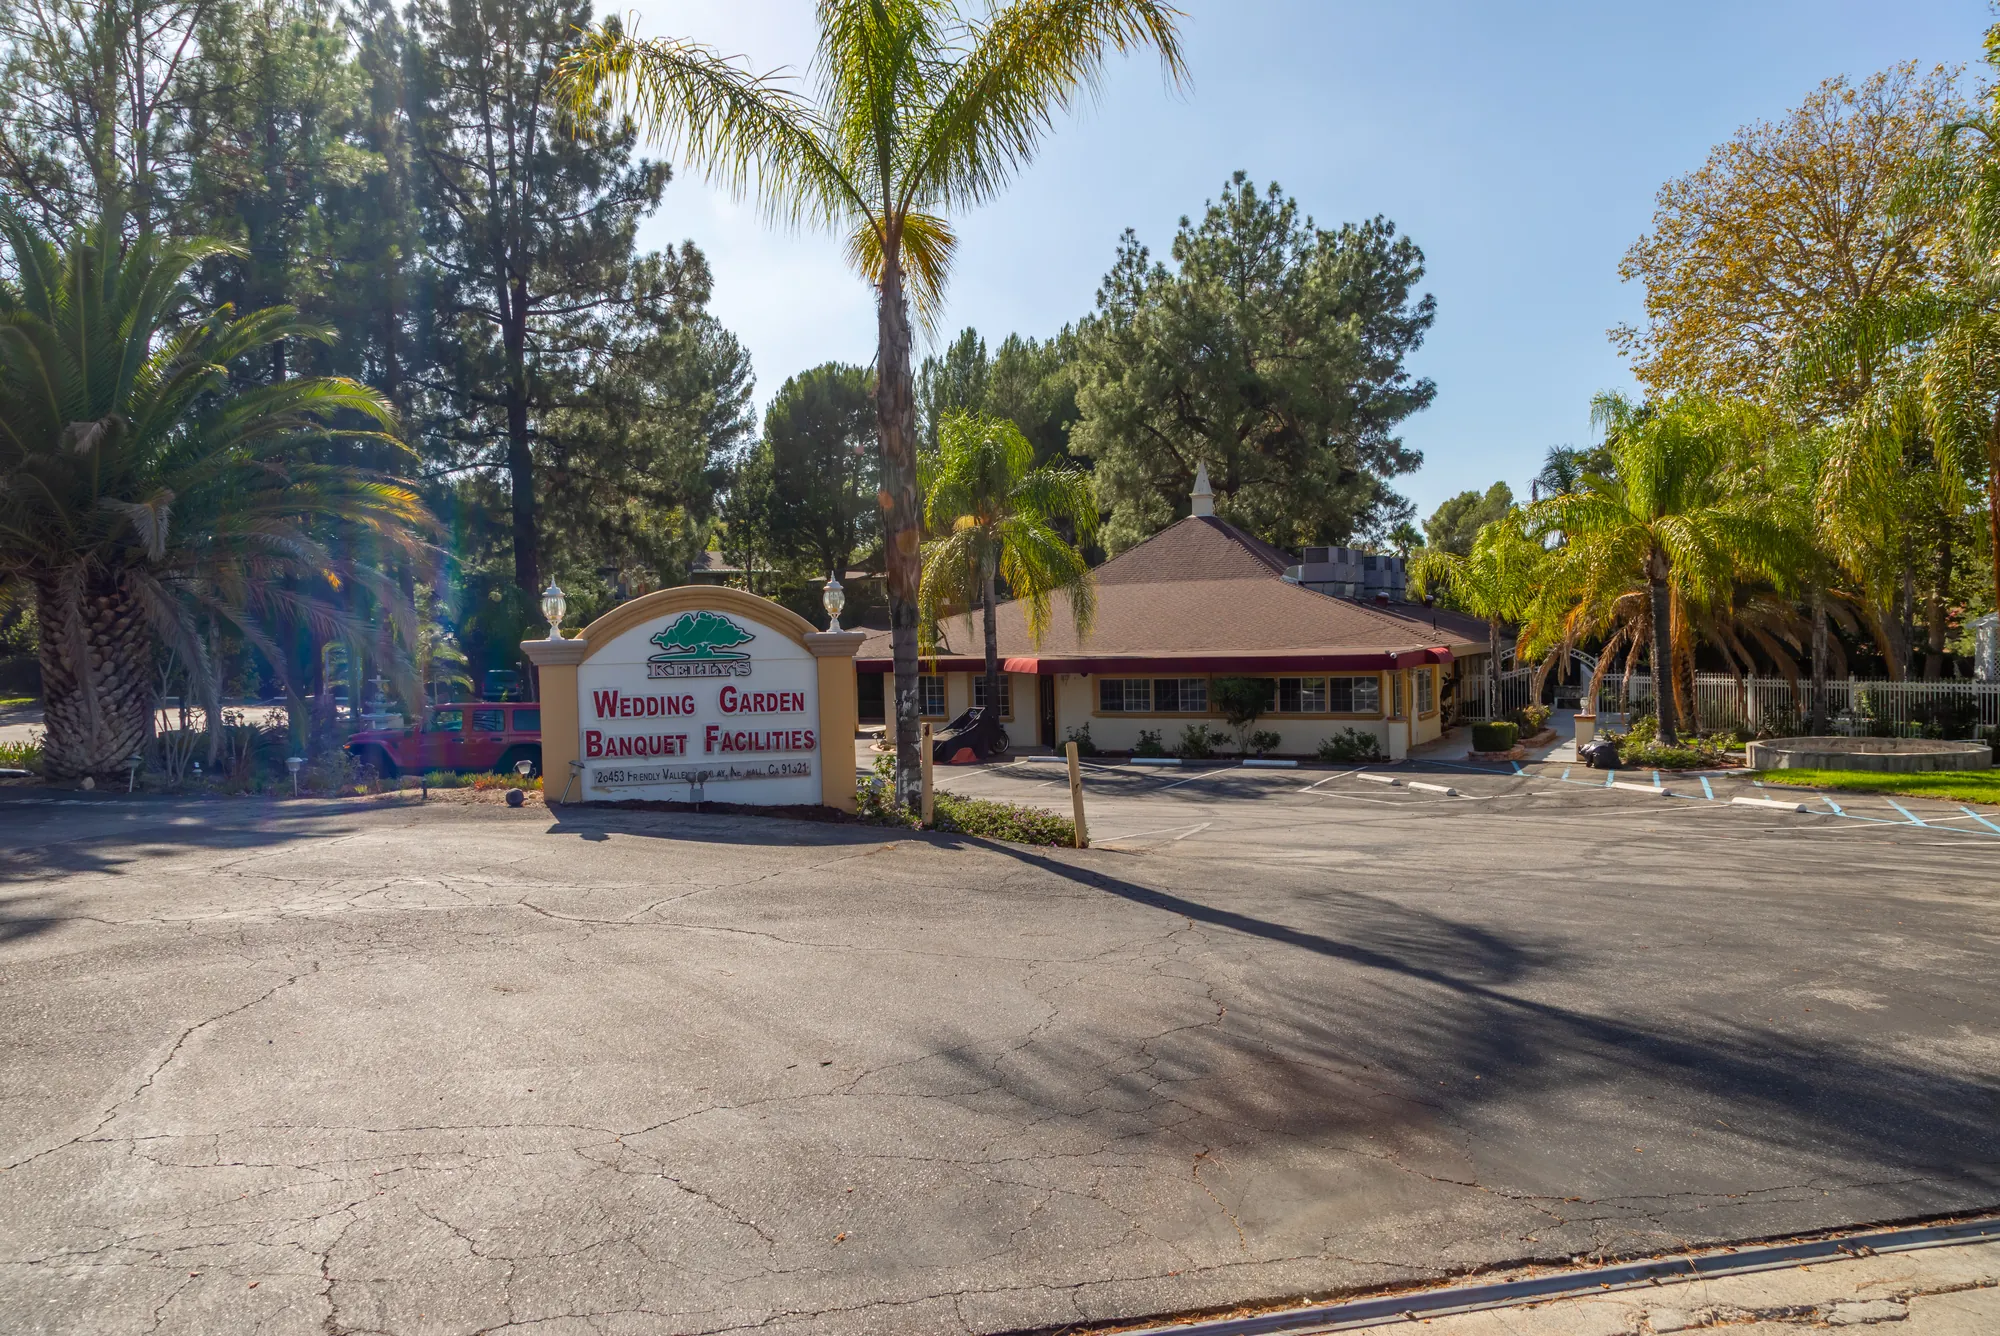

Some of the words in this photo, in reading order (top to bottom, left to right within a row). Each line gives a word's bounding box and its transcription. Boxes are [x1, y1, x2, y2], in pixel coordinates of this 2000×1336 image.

[647, 660, 752, 679] KELLY'S
[593, 690, 695, 718] WEDDING
[719, 686, 804, 713] GARDEN
[585, 730, 688, 758] BANQUET
[705, 725, 816, 753] FACILITIES
[597, 770, 625, 783] 20453
[627, 770, 661, 782] FRENDLY
